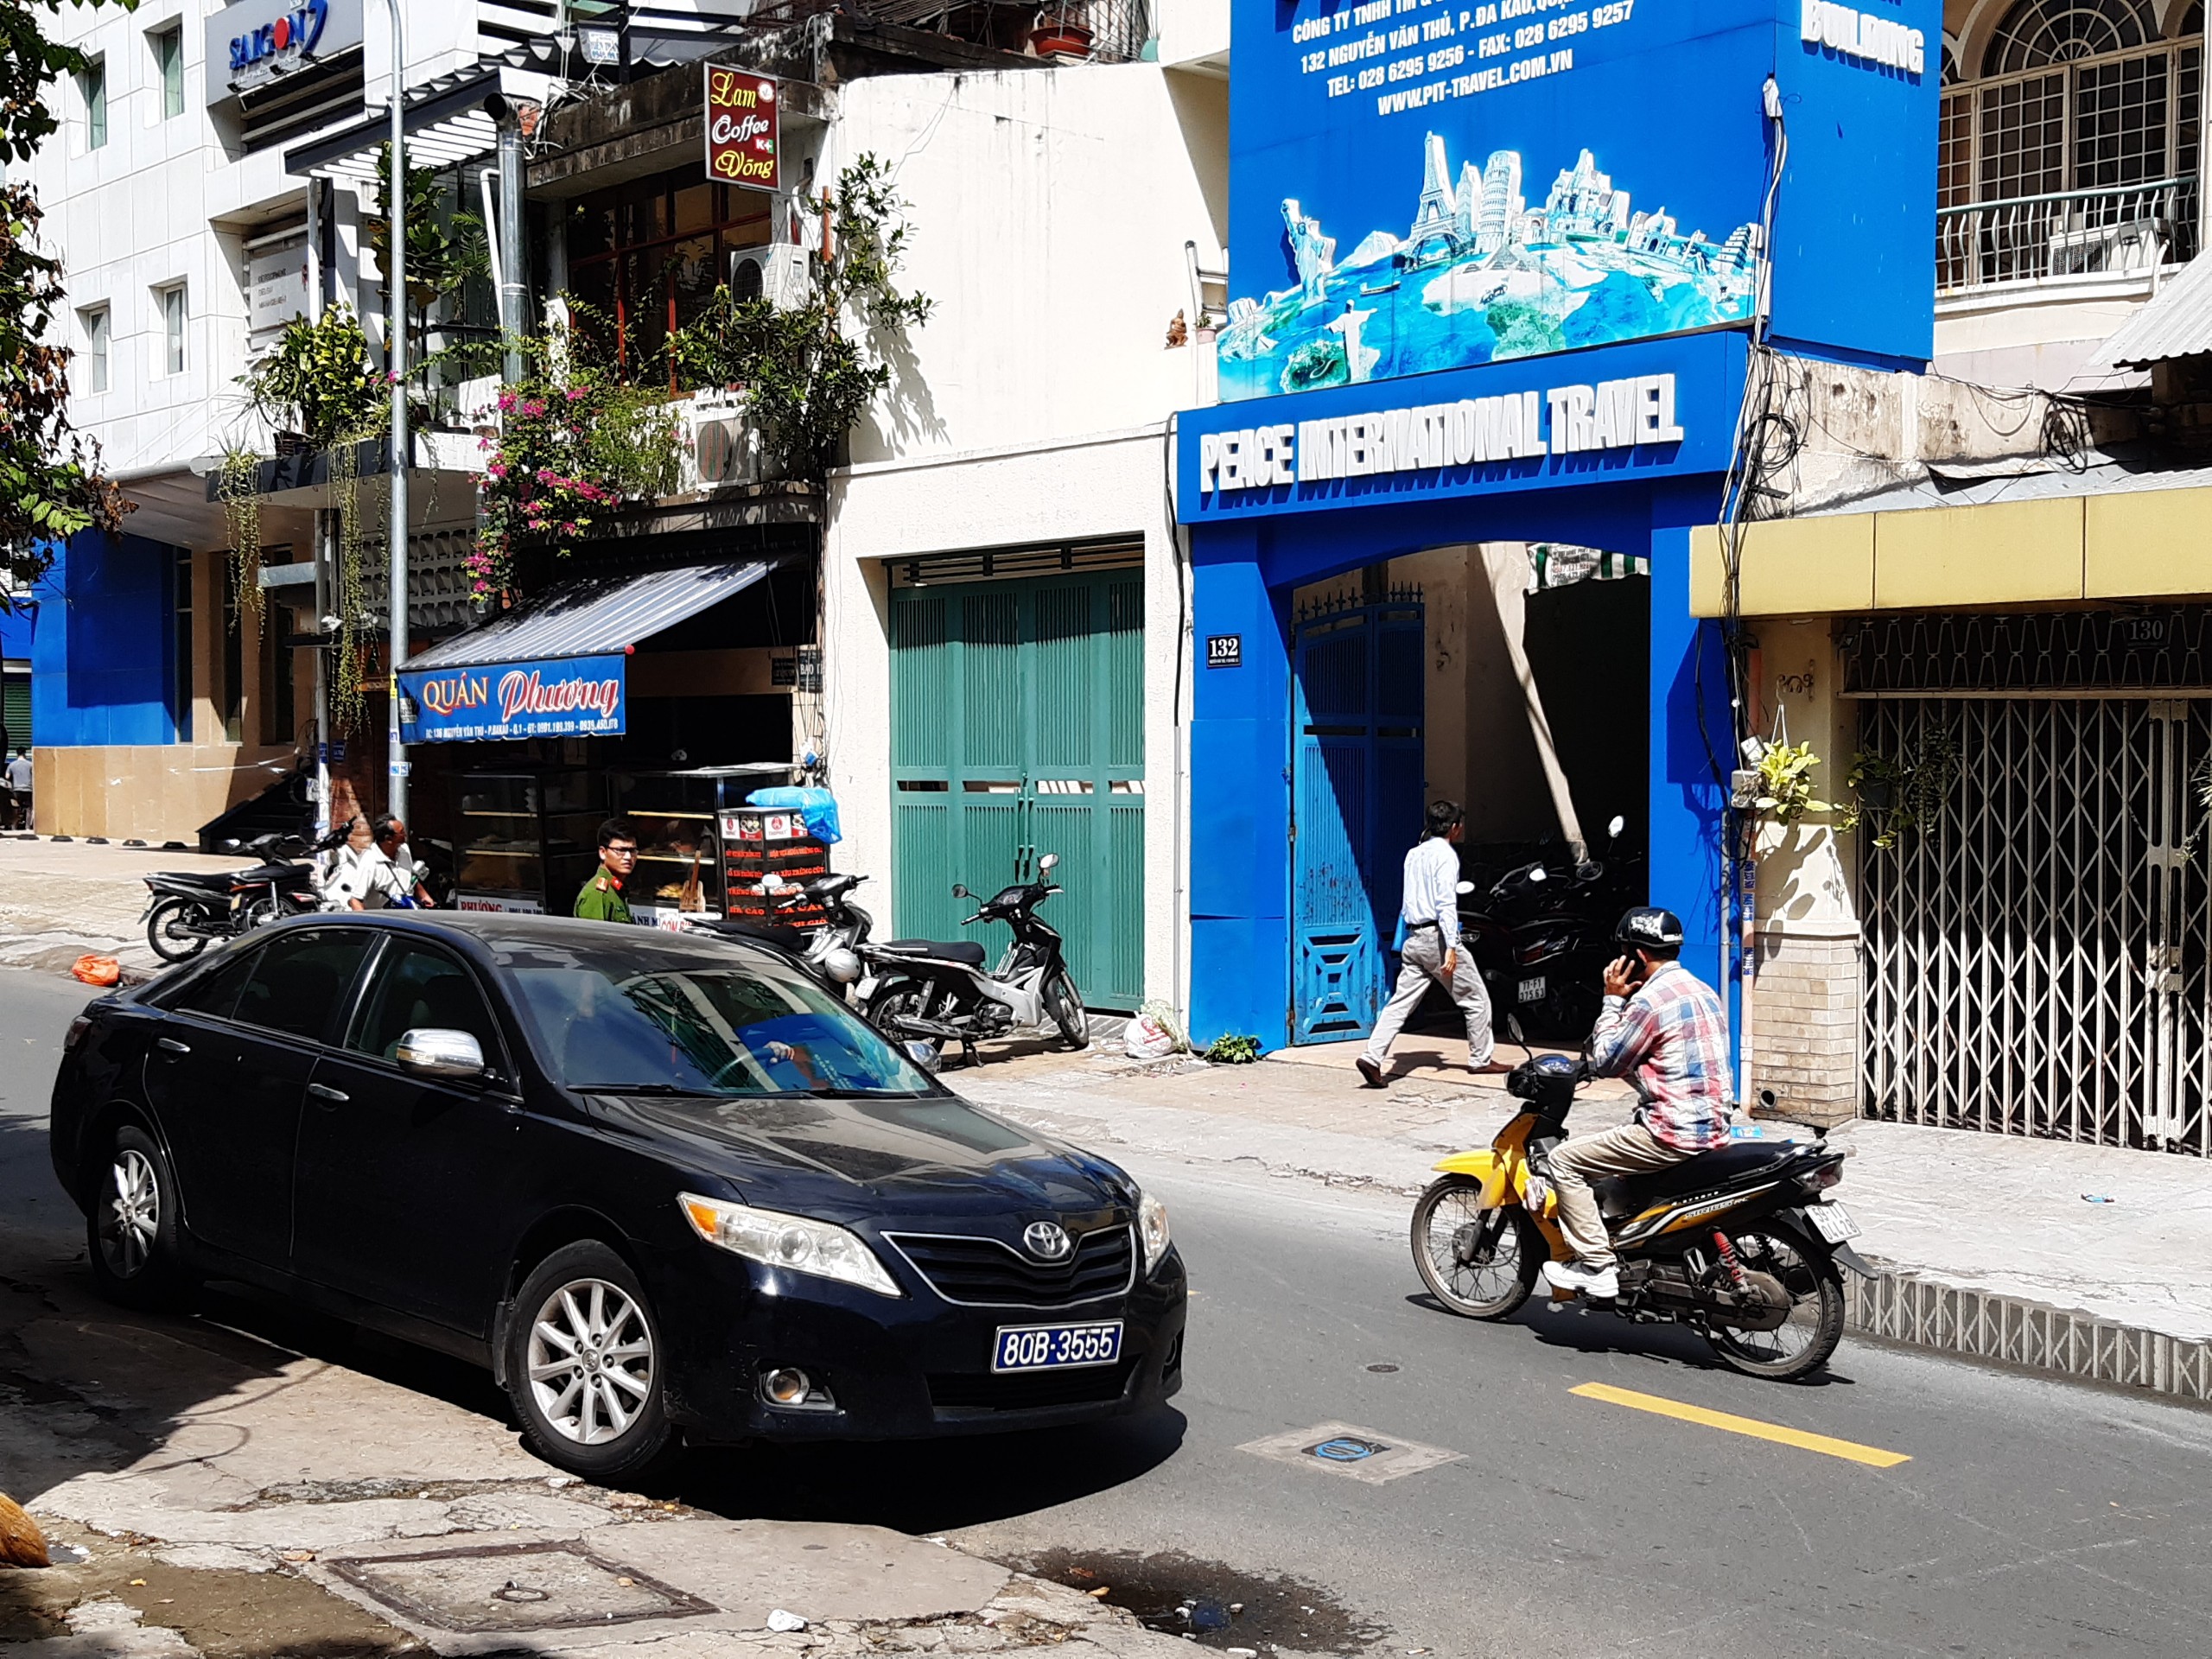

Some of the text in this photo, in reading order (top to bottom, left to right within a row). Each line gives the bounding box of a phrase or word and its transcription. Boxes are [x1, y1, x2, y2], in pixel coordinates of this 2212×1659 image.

[1293, 17, 1331, 44] CÔNG
[1333, 10, 1350, 32] TY
[1353, 0, 1392, 26] TNHH
[1300, 51, 1326, 74] 132
[1328, 30, 1386, 67] NGUYỄN
[1389, 24, 1419, 51] VĂN
[1421, 10, 1455, 41] THỦ,
[1801, 0, 1924, 74] BUILDING
[1327, 74, 1355, 98] TEL:
[1357, 66, 1384, 90] 028
[1388, 56, 1424, 83] 6295
[1427, 45, 1465, 73] 9256
[1478, 33, 1511, 59] FAX:
[1515, 23, 1544, 49] 028
[1548, 11, 1588, 41] 6295
[1592, 0, 1635, 29] 9257
[710, 73, 757, 109] Lam
[1377, 48, 1573, 117] WWW.PIT-TRAVEL.COM.VN
[712, 114, 769, 144] Coffee
[1200, 373, 1684, 493] PEACE INTERNATIONAL TRAVEL
[1210, 638, 1238, 658] 132
[2130, 620, 2164, 640] 130
[423, 671, 489, 716] QUÁN
[498, 669, 619, 723] Phương
[1003, 1326, 1116, 1366] 80B-3555
